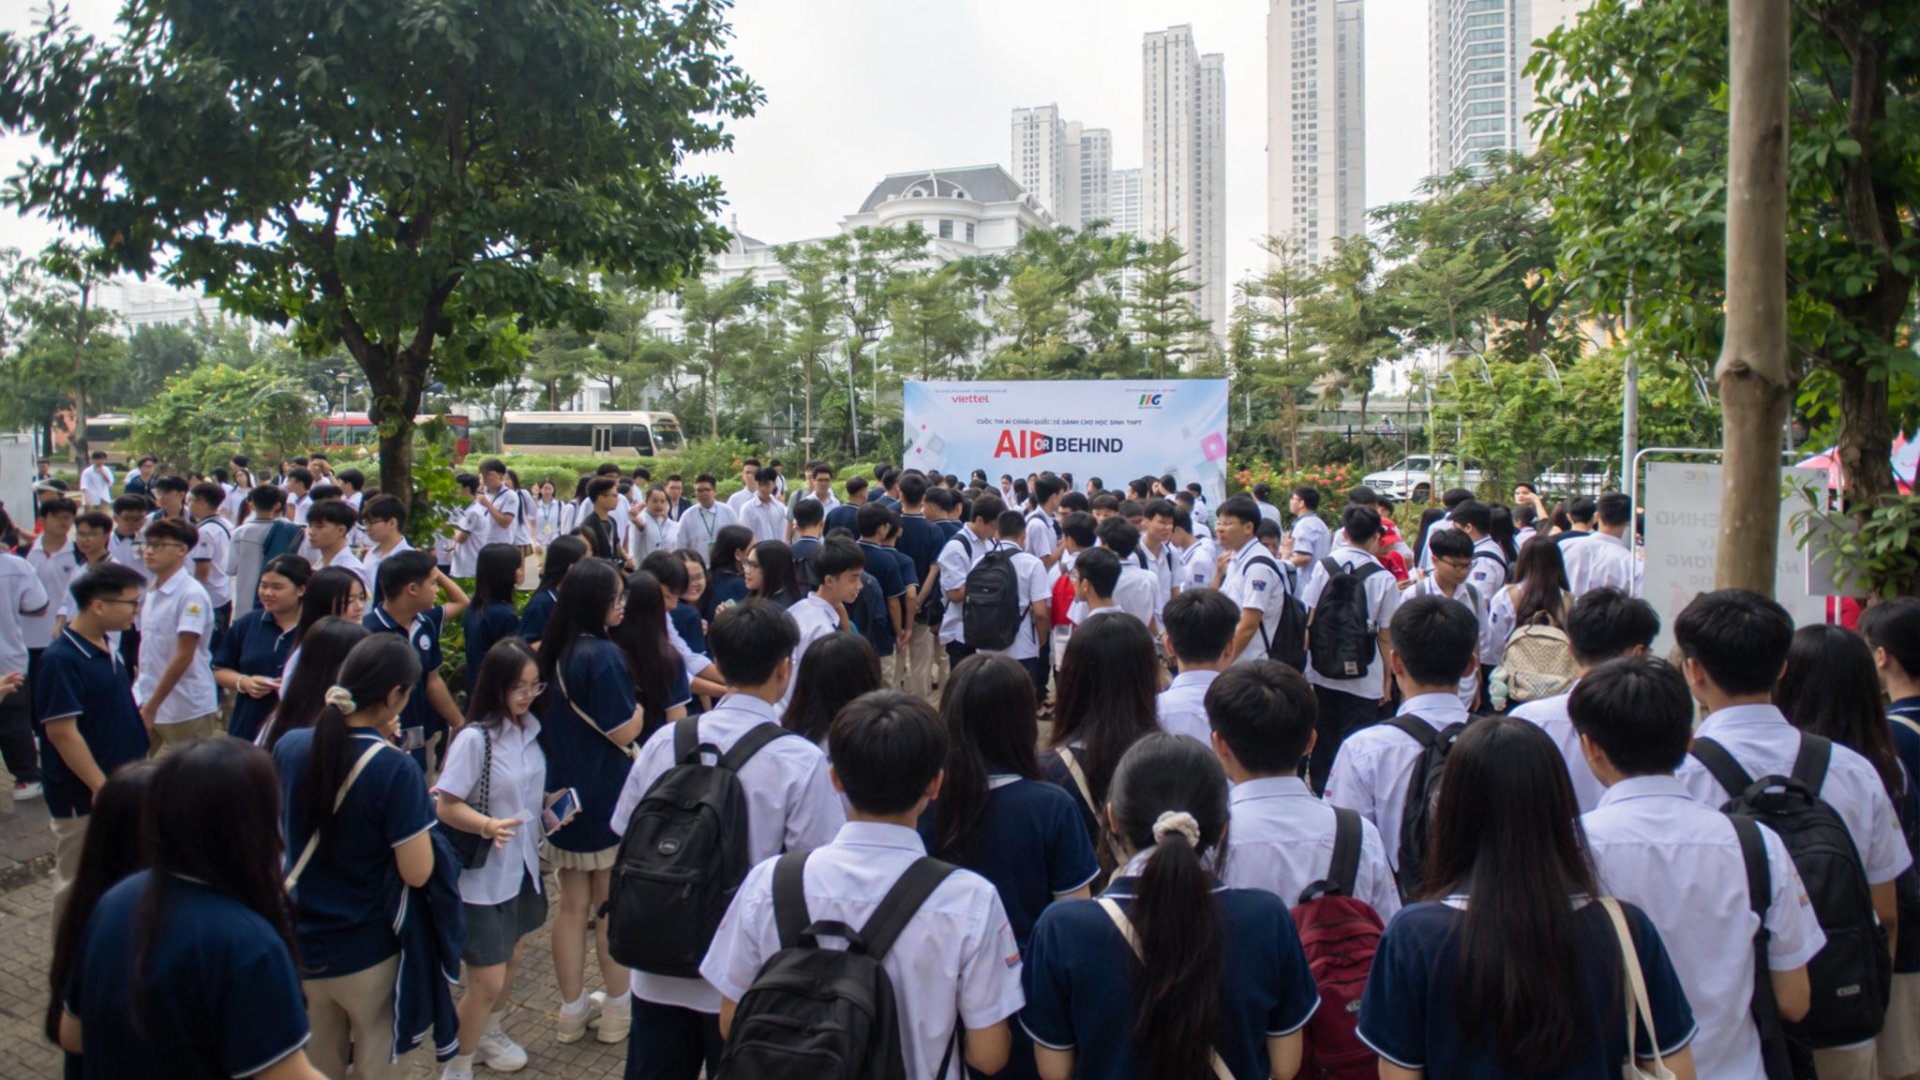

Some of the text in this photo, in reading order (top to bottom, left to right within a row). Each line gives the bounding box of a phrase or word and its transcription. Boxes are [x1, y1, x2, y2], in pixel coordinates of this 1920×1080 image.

[952, 395, 989, 403] viettel
[994, 429, 1123, 458] AI OR BEHIND
